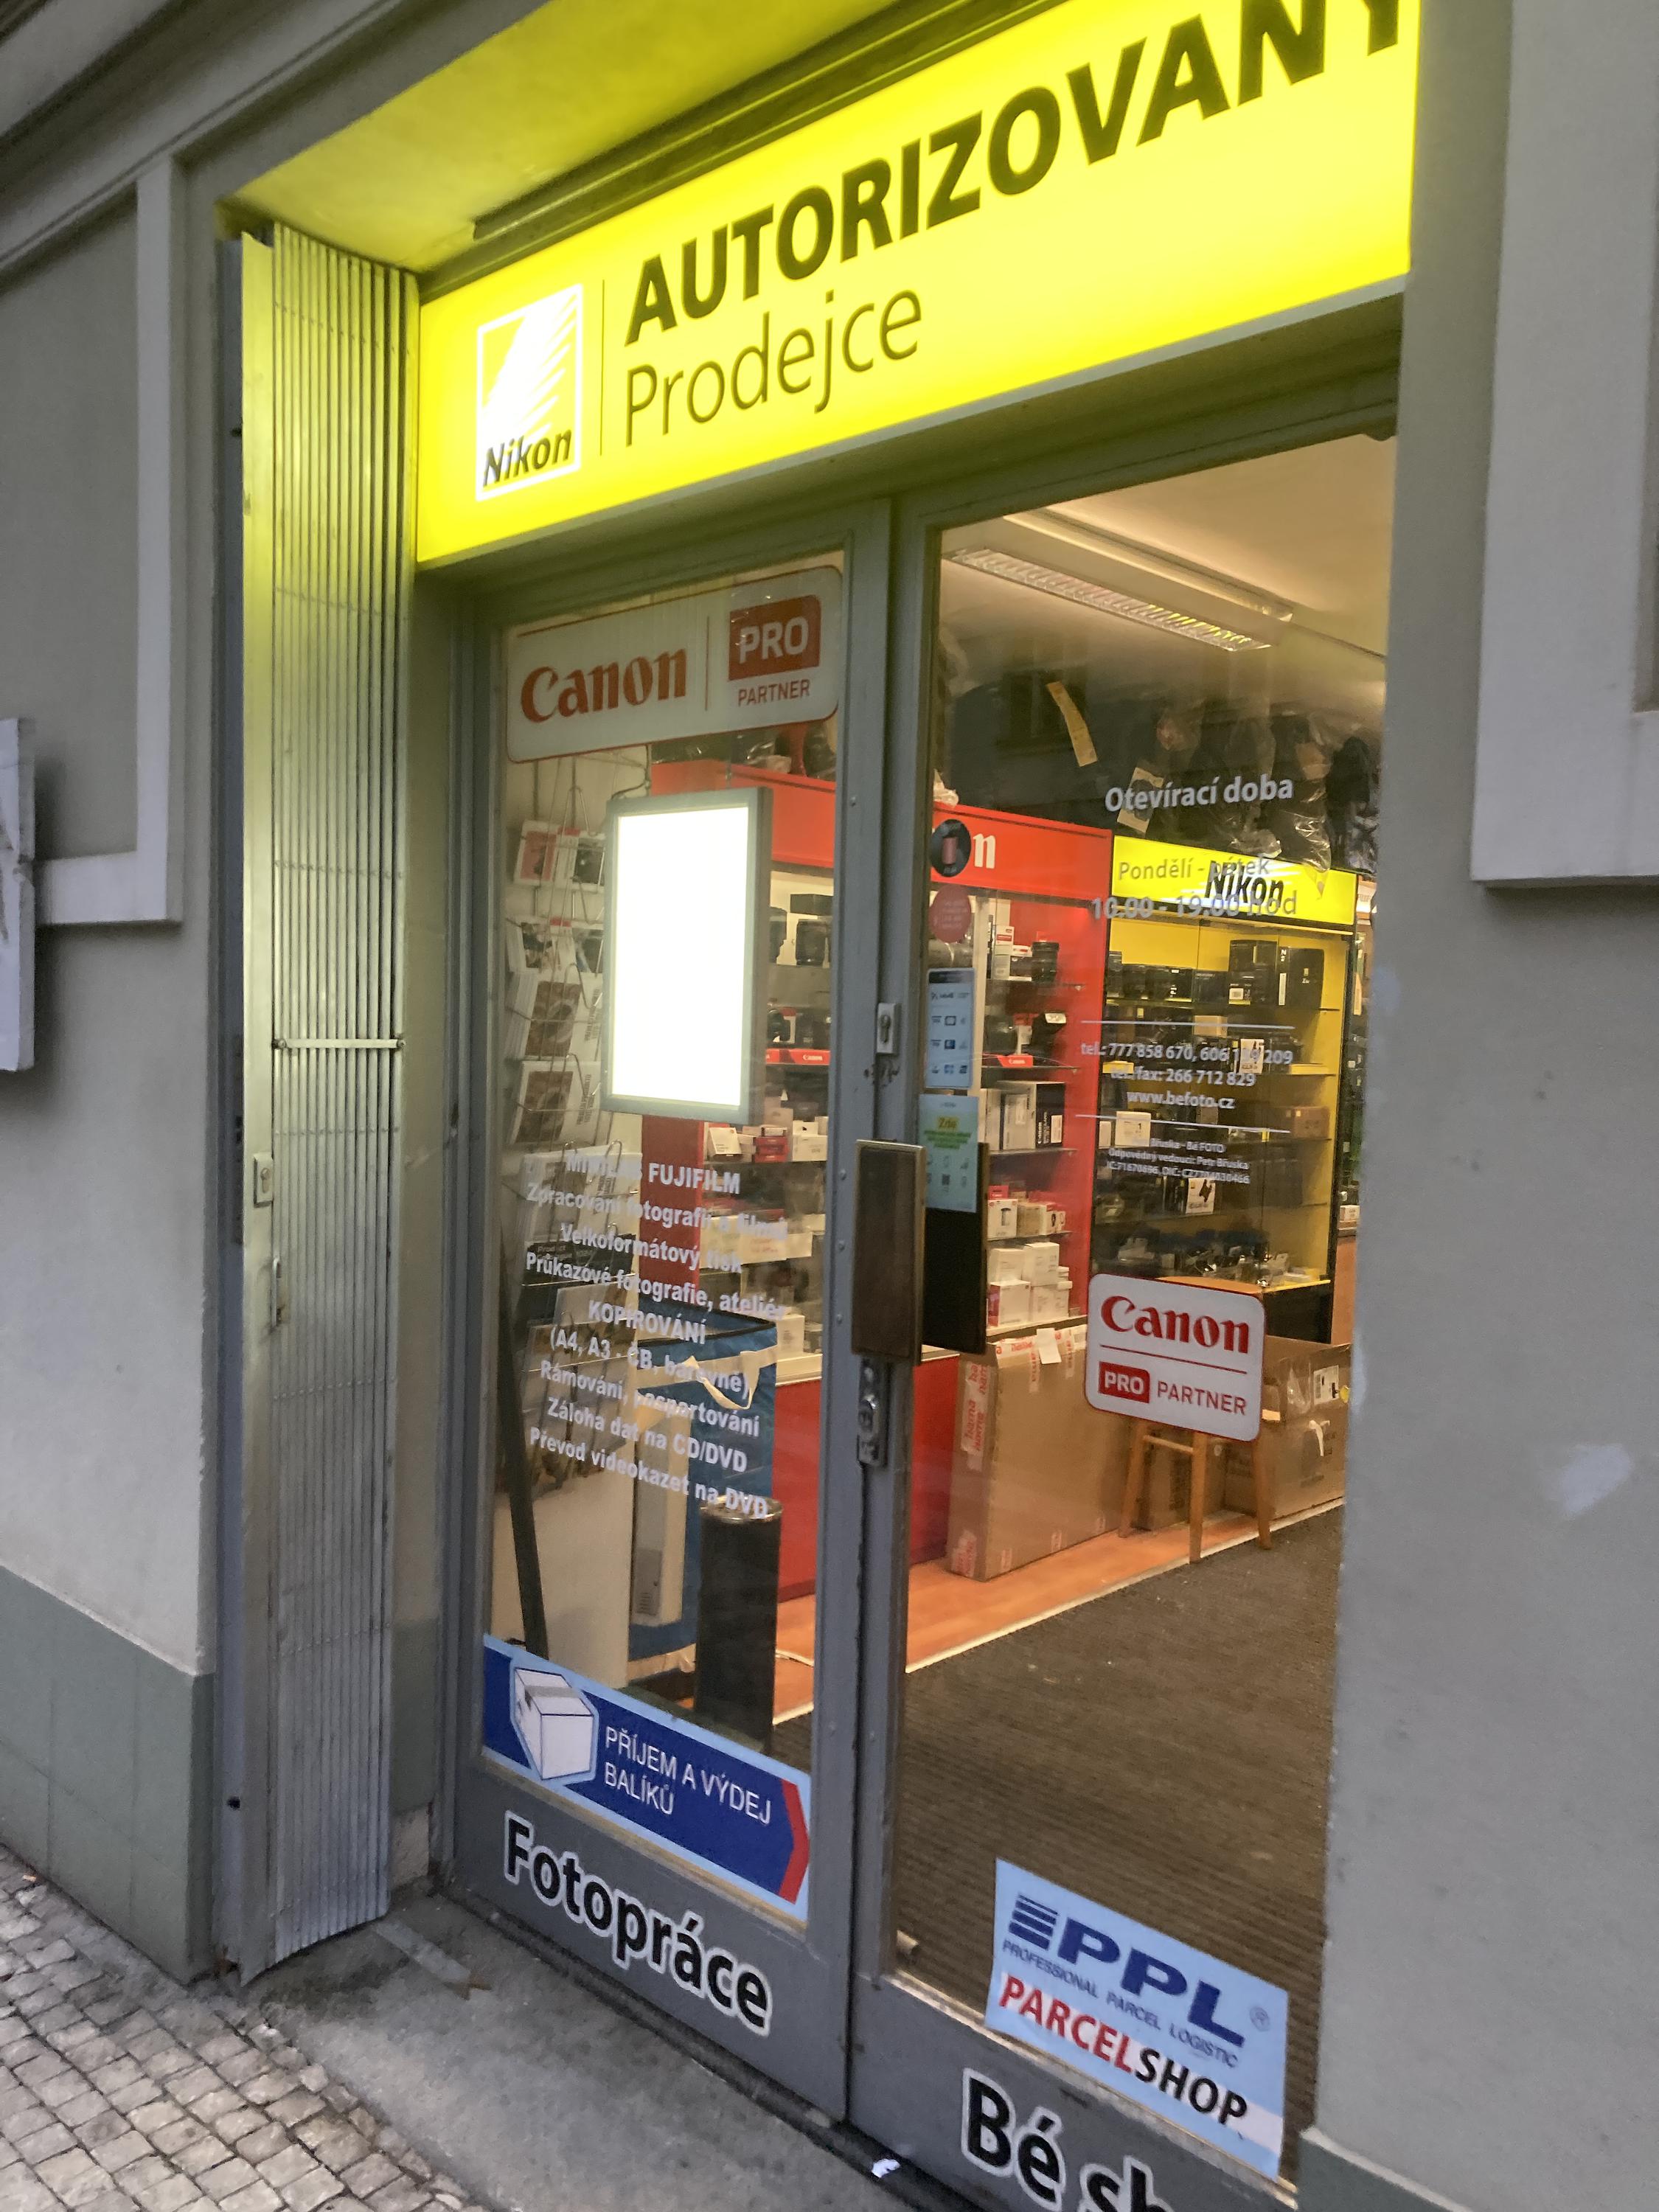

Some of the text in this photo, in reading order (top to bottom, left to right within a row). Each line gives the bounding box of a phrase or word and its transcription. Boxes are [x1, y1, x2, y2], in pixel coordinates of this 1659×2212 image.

[626, 288, 922, 448] Prodejce
[482, 429, 571, 487] Nikon
[739, 616, 809, 664] PRO
[521, 648, 686, 723] Canon
[738, 678, 810, 706] PARTNER
[1105, 773, 1293, 811] Otevírací doba
[1119, 858, 1194, 880] Pondělí
[1205, 860, 1284, 908] Nikon
[1109, 1043, 1133, 1057] 777
[1136, 1043, 1164, 1058] 858
[1264, 1049, 1294, 1065] 209
[1166, 1068, 1192, 1083] 266
[1196, 1070, 1224, 1085] 712
[1226, 1071, 1257, 1087] 829
[649, 1163, 740, 1194] FUJIFILM
[561, 1222, 700, 1270] Velkoformátový
[526, 1251, 785, 1321] Průkazové fotografie, ateliér
[589, 1300, 706, 1344] KOPÍROVÁNÍ
[1101, 1295, 1249, 1354] Canon
[551, 1326, 582, 1357] (A4,
[588, 1337, 611, 1360] A3
[627, 1340, 658, 1375] ČB,
[540, 1359, 627, 1405] Rámování,
[1105, 1371, 1247, 1416] PRO PARTNER
[548, 1397, 748, 1472] Záloha dat na CD/DVD
[531, 1426, 768, 1519] Převod videokazet na DVD
[604, 1761, 675, 1815] BALÍKŮ
[605, 1725, 772, 1825] PŘÍJEM A VÝDEJ
[506, 1812, 771, 2034] Fotopráce
[1002, 1938, 1239, 2068] PROFESSIONAL PARCEL LOGISTIC
[1057, 1916, 1245, 2048] PPL
[998, 1975, 1248, 2126] PARCELSHOP
[963, 2069, 1065, 2211] Bé
